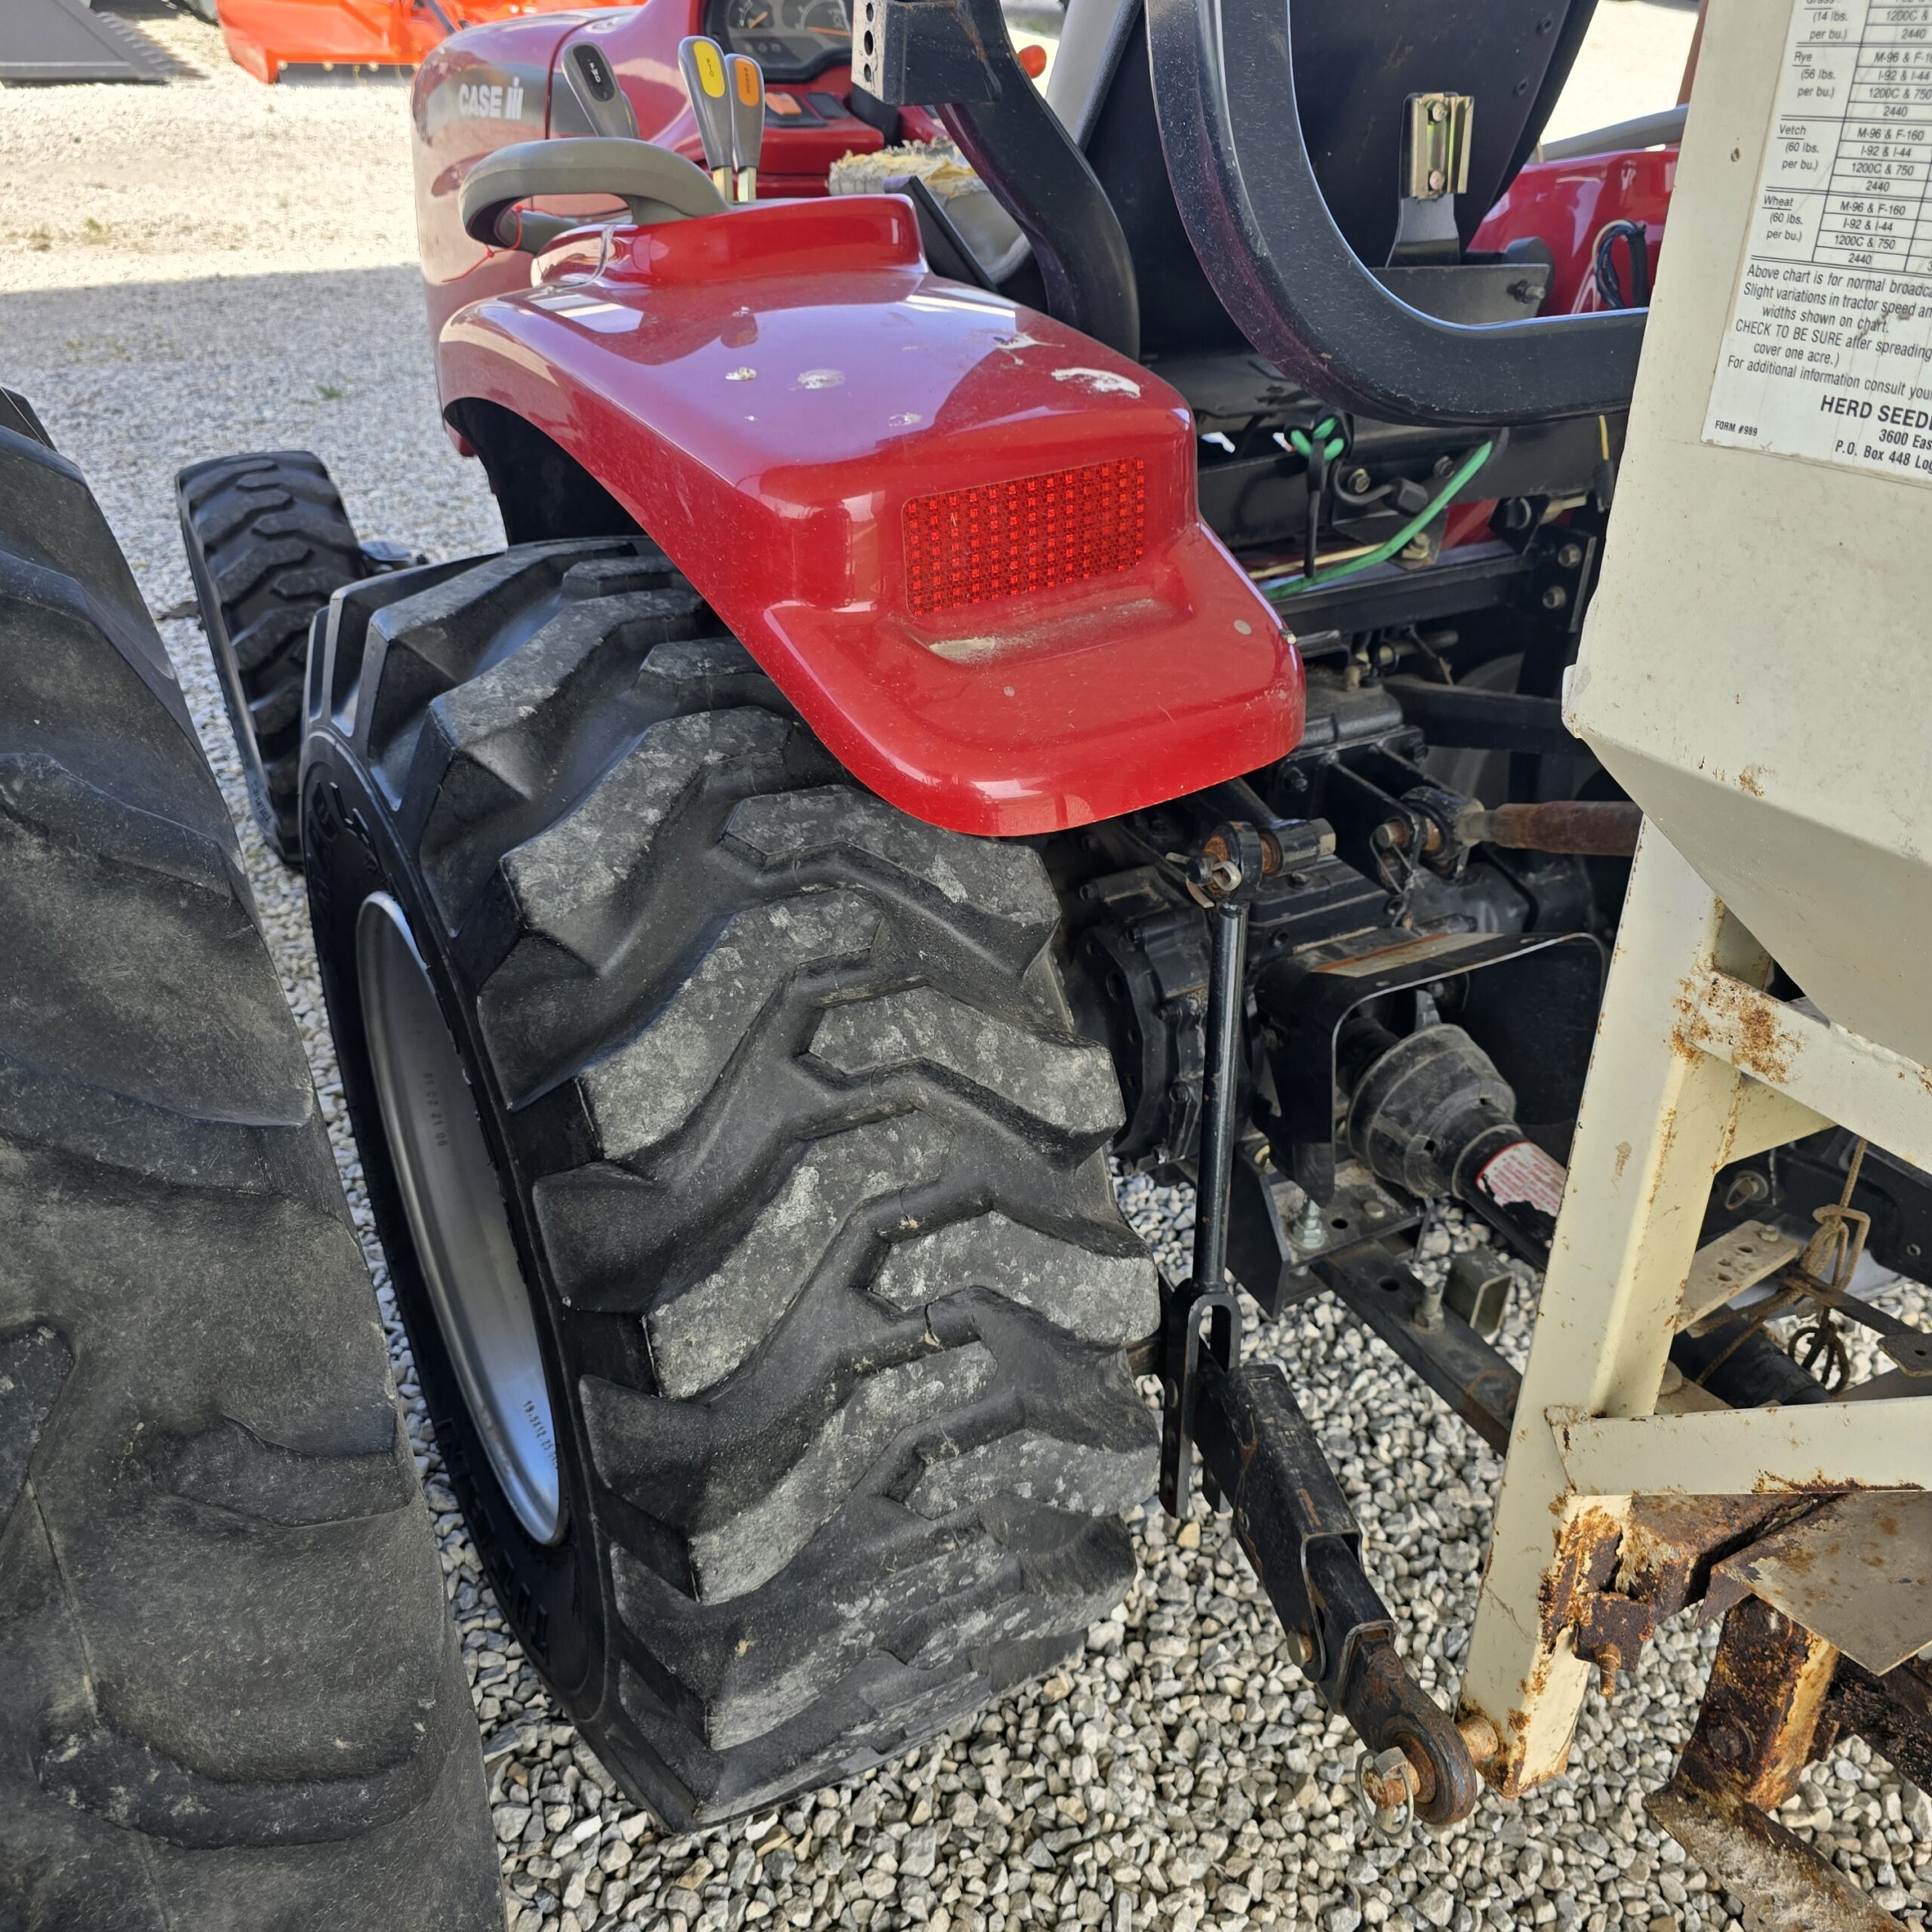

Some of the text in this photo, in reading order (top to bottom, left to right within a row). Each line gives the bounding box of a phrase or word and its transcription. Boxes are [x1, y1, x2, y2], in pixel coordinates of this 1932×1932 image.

[1813, 11, 1847, 23] (14 lbs.
[1887, 10, 1928, 21] 1200C &
[1810, 29, 1847, 41] per bu.)
[1901, 28, 1926, 39] 2440
[1795, 51, 1813, 64] Rye
[1875, 52, 1900, 63] M-96
[1902, 52, 1909, 63] &
[1801, 69, 1835, 81] (56 lbs.
[1900, 71, 1907, 82] &
[1797, 87, 1835, 99] per bu.)
[1869, 88, 1932, 100] 1200C & 750
[459, 83, 503, 118] CASE
[1883, 106, 1908, 118] 2440
[1780, 124, 1806, 136] Vetch
[1857, 128, 1924, 141] M-96 & F-160
[1786, 142, 1820, 154] (60 lbs.
[1882, 146, 1889, 157] &
[1782, 158, 1818, 171] per bu.)
[1852, 162, 1915, 176] 1200C & 750
[1866, 180, 1890, 192] 2440
[1764, 195, 1793, 208] Wheat
[1840, 201, 1906, 216] M-96 & F-160
[1769, 212, 1804, 225] (60 lbs.
[1864, 220, 1872, 230] &
[1766, 229, 1802, 242] per bu.)
[1835, 235, 1896, 250] 1200C & 750
[1847, 253, 1872, 265] 2440
[1747, 264, 1780, 280] Above
[1783, 268, 1810, 285] chart
[1814, 272, 1823, 285] is
[1827, 272, 1843, 287] for
[1846, 275, 1886, 292] normal
[1744, 282, 1774, 300] Slight
[1777, 288, 1826, 305] variations
[1829, 293, 1840, 306] in
[1842, 295, 1879, 311] tractor
[1882, 301, 1917, 318] speed
[1762, 304, 1890, 334] widths shown on chart.
[1736, 318, 1932, 362] CHECK TO BE SURE after spreading
[1754, 342, 1840, 368] cover one acre.)
[1727, 355, 1744, 369] For
[1747, 358, 1797, 378] additional
[1800, 367, 1860, 389] information
[1864, 377, 1906, 396] consult
[1820, 395, 1872, 419] HERD
[1715, 420, 1758, 436] FORM #989
[1879, 429, 1932, 451] 3600 Eas
[1835, 440, 1857, 456] P.O.
[1864, 445, 1884, 462] Box
[1888, 451, 1911, 466] 448
